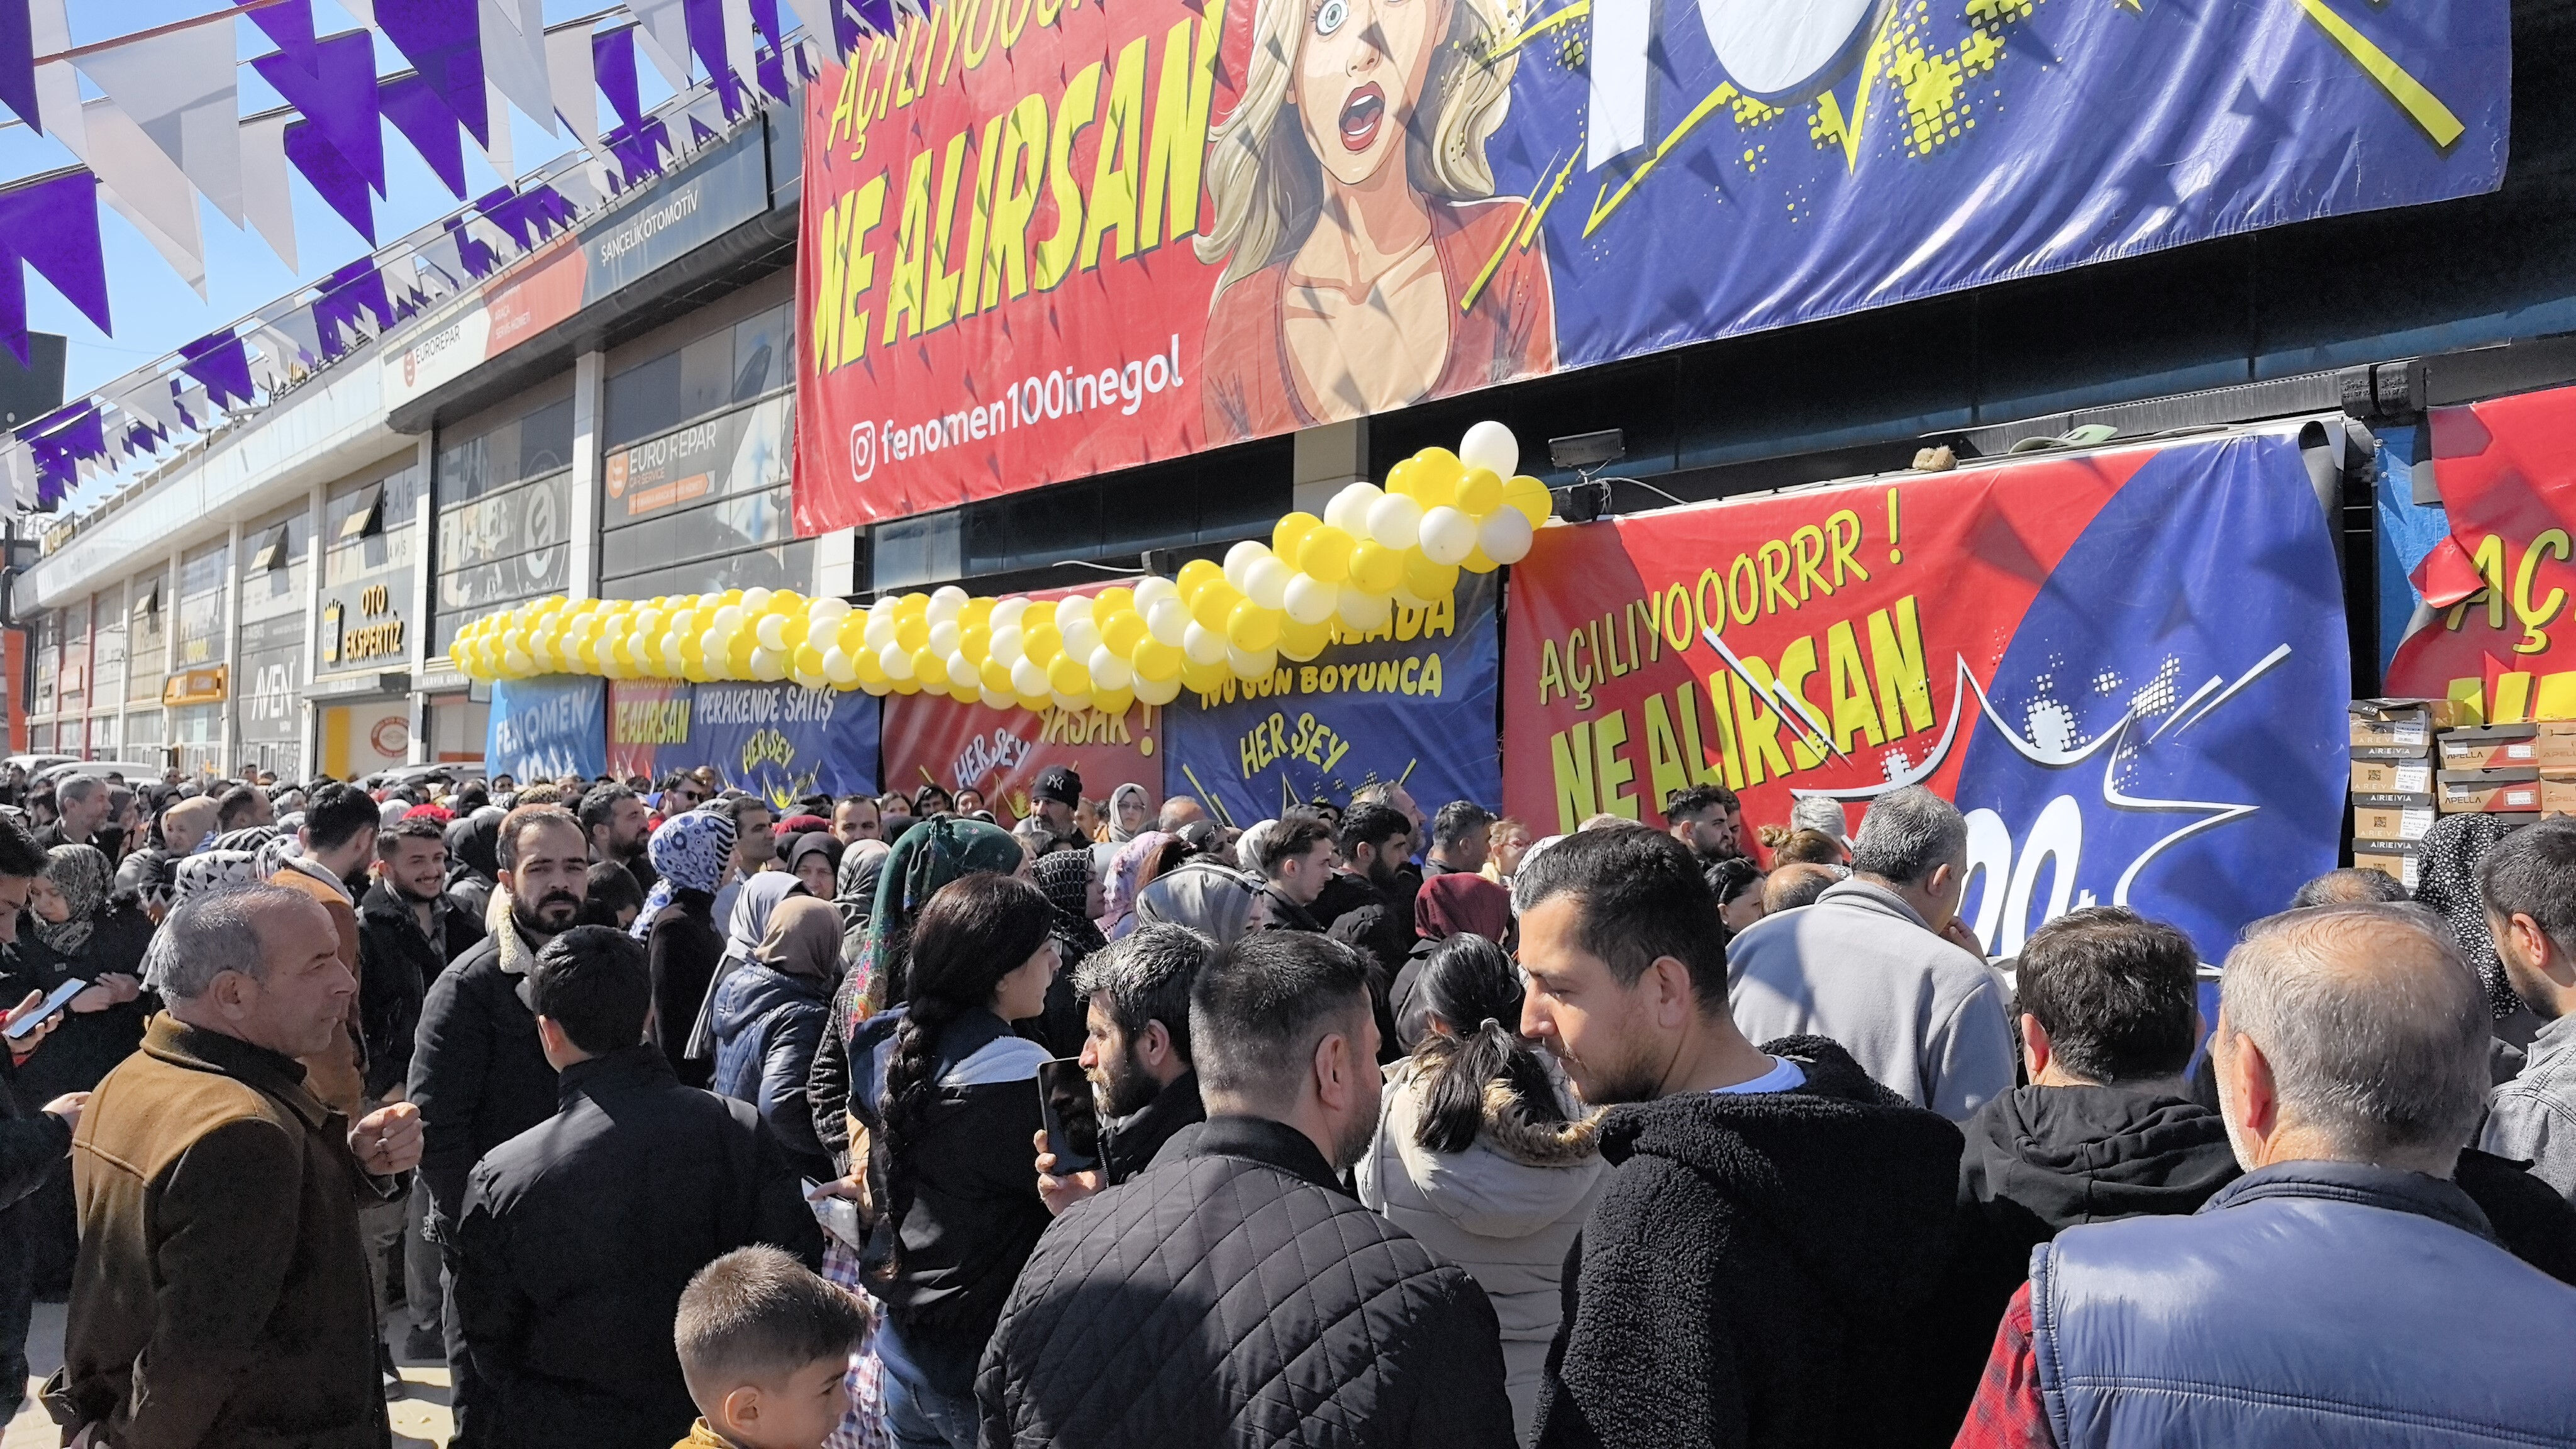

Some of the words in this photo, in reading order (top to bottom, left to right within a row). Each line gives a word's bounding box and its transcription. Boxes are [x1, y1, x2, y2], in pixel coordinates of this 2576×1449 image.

[814, 169, 887, 377] NE
[882, 0, 1227, 348] ALIRSAN
[601, 223, 644, 267] ŞANÇELİK
[643, 189, 698, 238] OTOMOTİV
[415, 325, 461, 365] EUROREPAR
[880, 333, 1184, 464] fenomen100inegol
[630, 440, 667, 475] EURO
[360, 584, 386, 617] OTO
[1539, 508, 1870, 710] AÇILIYOOORRR
[1886, 486, 1903, 565] !
[1299, 653, 1443, 698] BOYUNCA
[496, 686, 587, 757] FENOMEN
[628, 698, 691, 745] ALIRSAN
[700, 687, 781, 726] PERAKENDE
[784, 685, 838, 733] SATIŞ
[1550, 708, 1640, 834] NE
[1644, 594, 1936, 814] ALIRSAN
[742, 727, 767, 775] HER
[953, 733, 986, 789] HER
[1240, 712, 1289, 779] HER
[2445, 796, 2482, 804] APELLA
